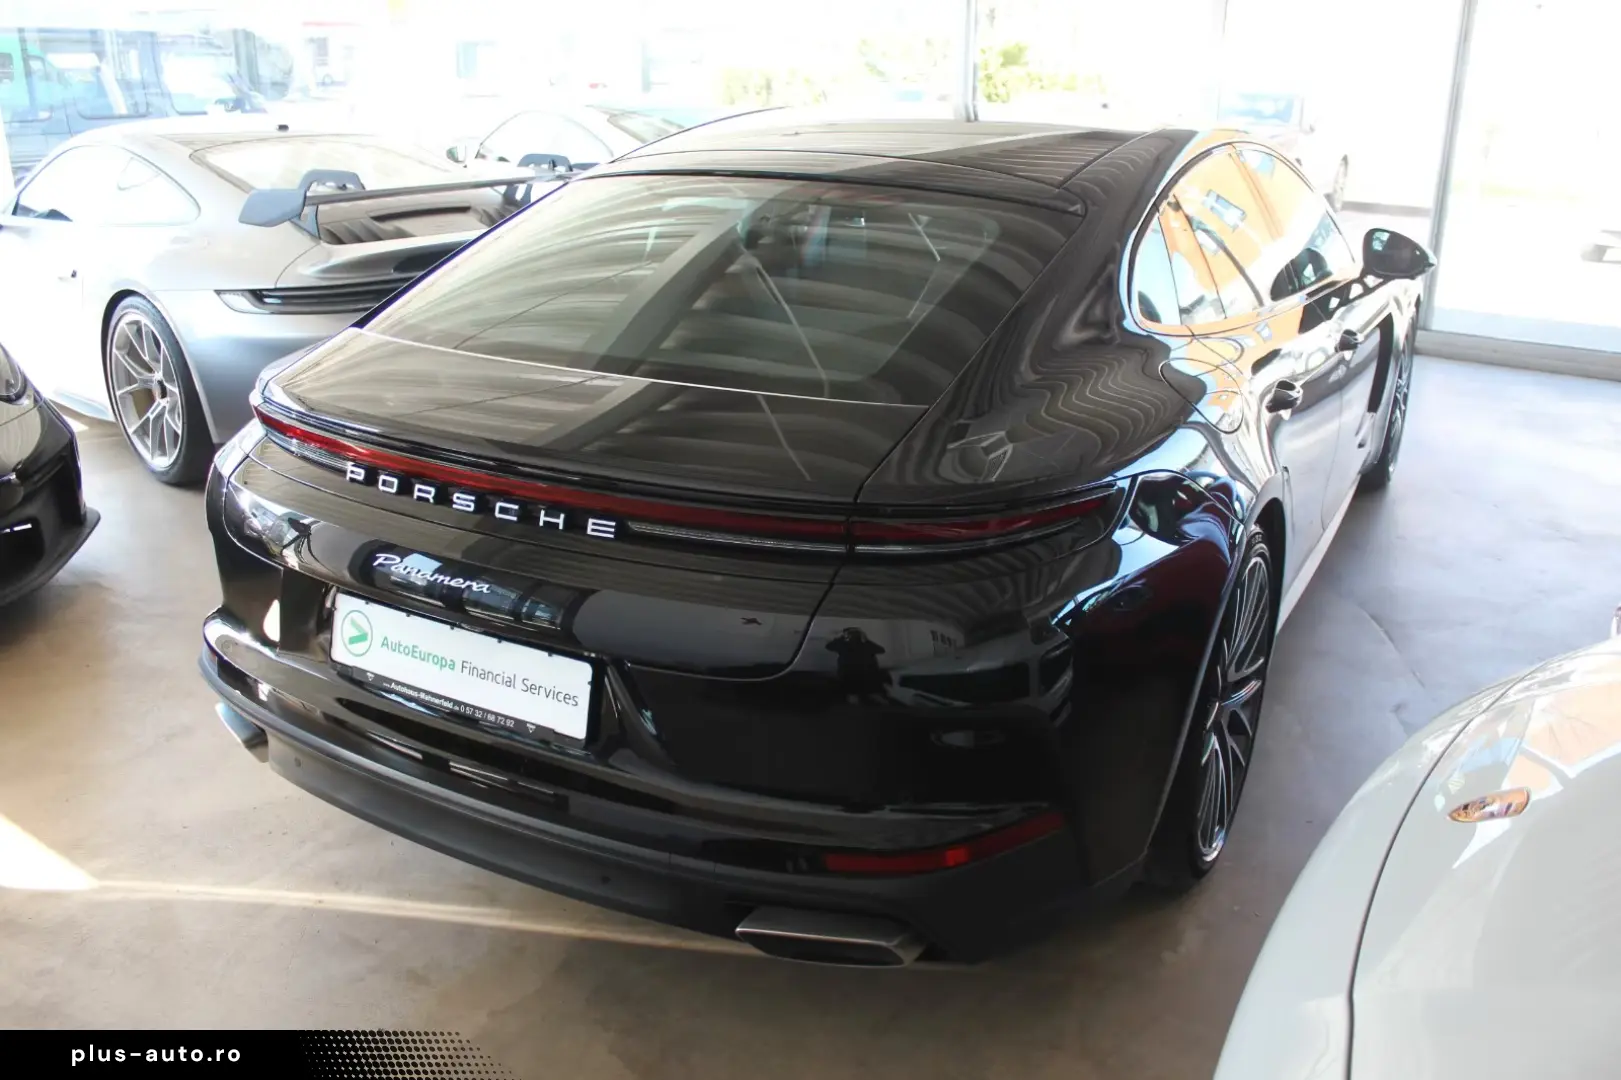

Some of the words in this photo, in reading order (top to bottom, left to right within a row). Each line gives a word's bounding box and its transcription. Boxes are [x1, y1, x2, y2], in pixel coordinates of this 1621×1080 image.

[346, 461, 616, 538] PORSCHE
[373, 553, 491, 593] Panamera
[381, 636, 456, 671] AutoEuropa
[461, 660, 516, 689] Financial
[521, 678, 580, 707] Services
[475, 709, 483, 718] 32
